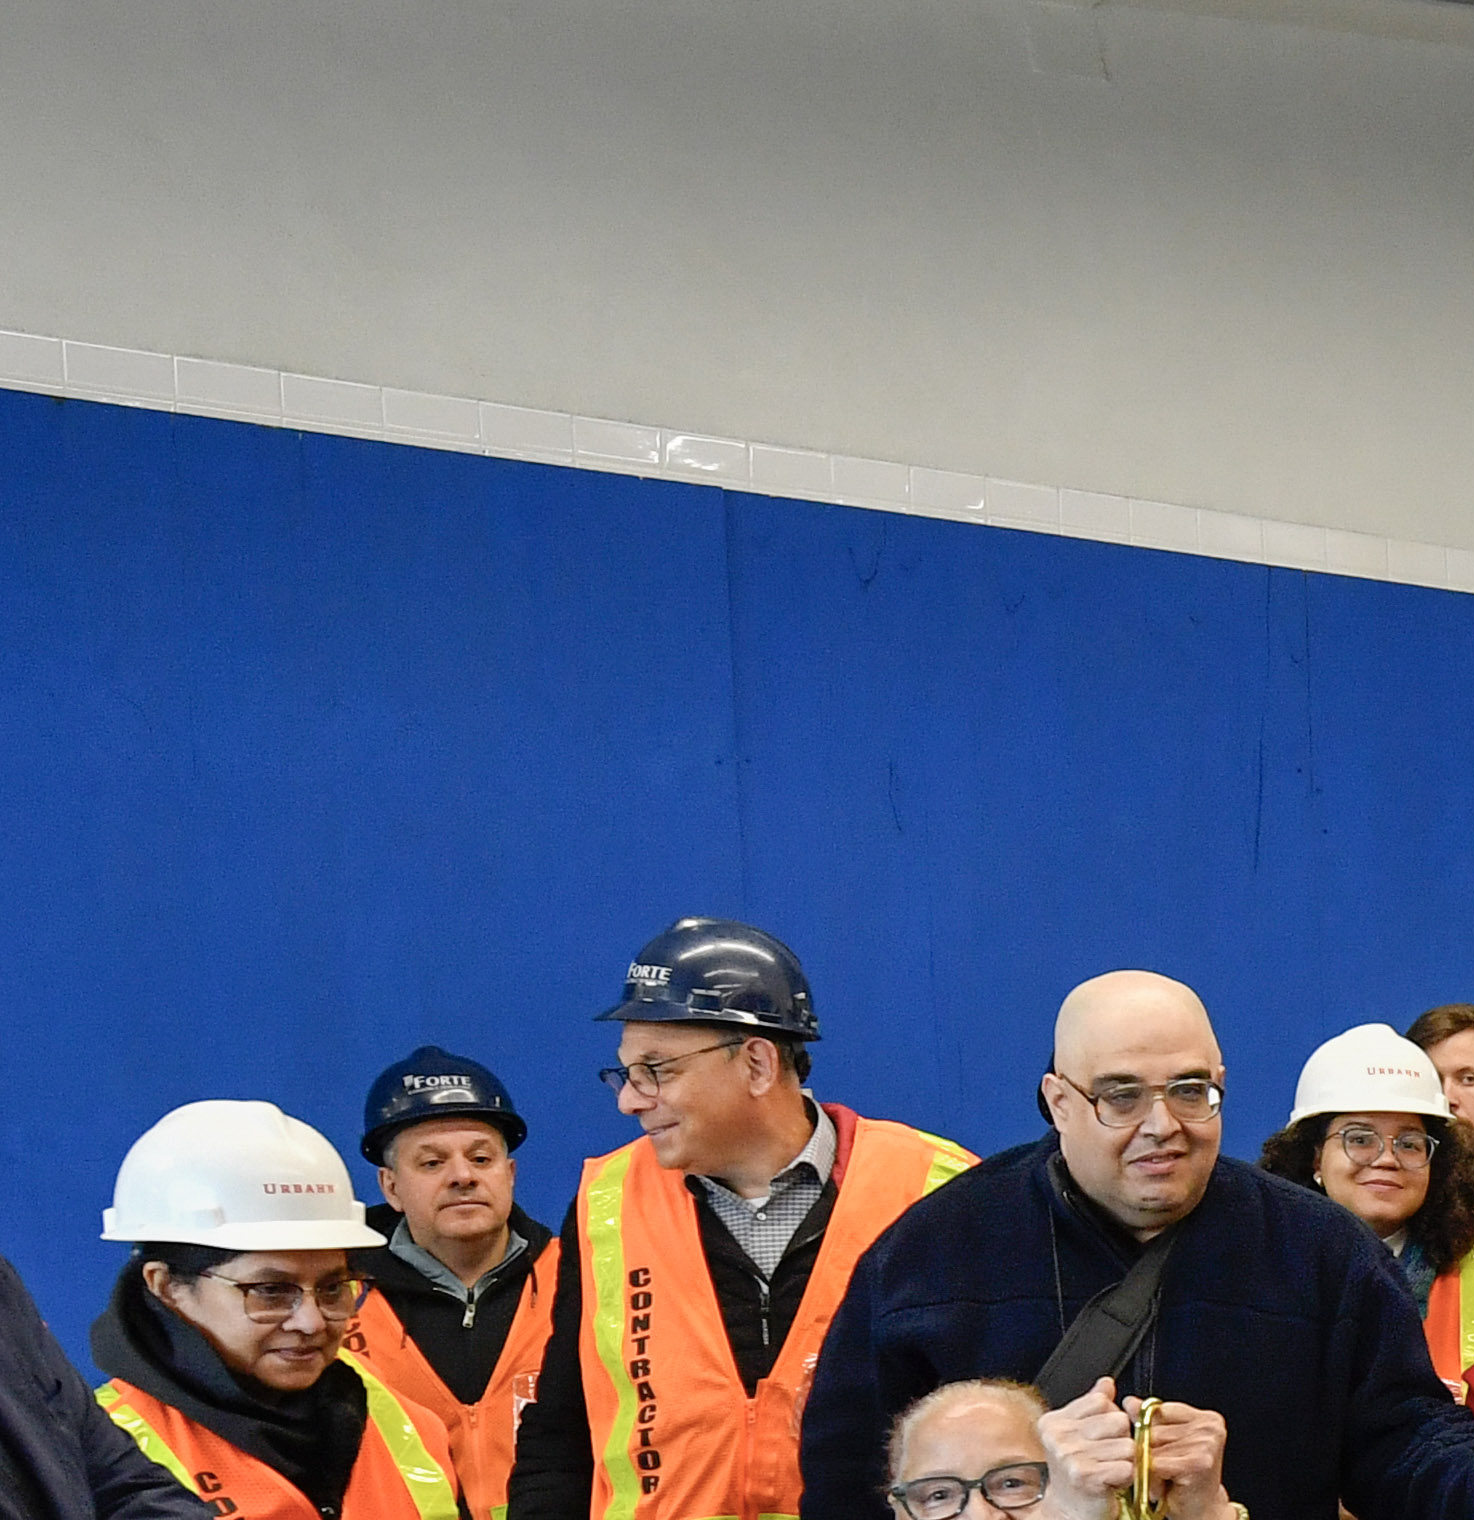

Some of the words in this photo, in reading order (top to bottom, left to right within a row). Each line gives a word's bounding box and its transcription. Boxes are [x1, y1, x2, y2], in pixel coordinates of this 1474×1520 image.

[627, 961, 673, 981] FORTE
[1367, 1066, 1421, 1078] URBAHN
[413, 1074, 473, 1089] FORTE
[263, 1183, 335, 1195] URBAHN
[628, 1267, 661, 1495] CONTRACTOR
